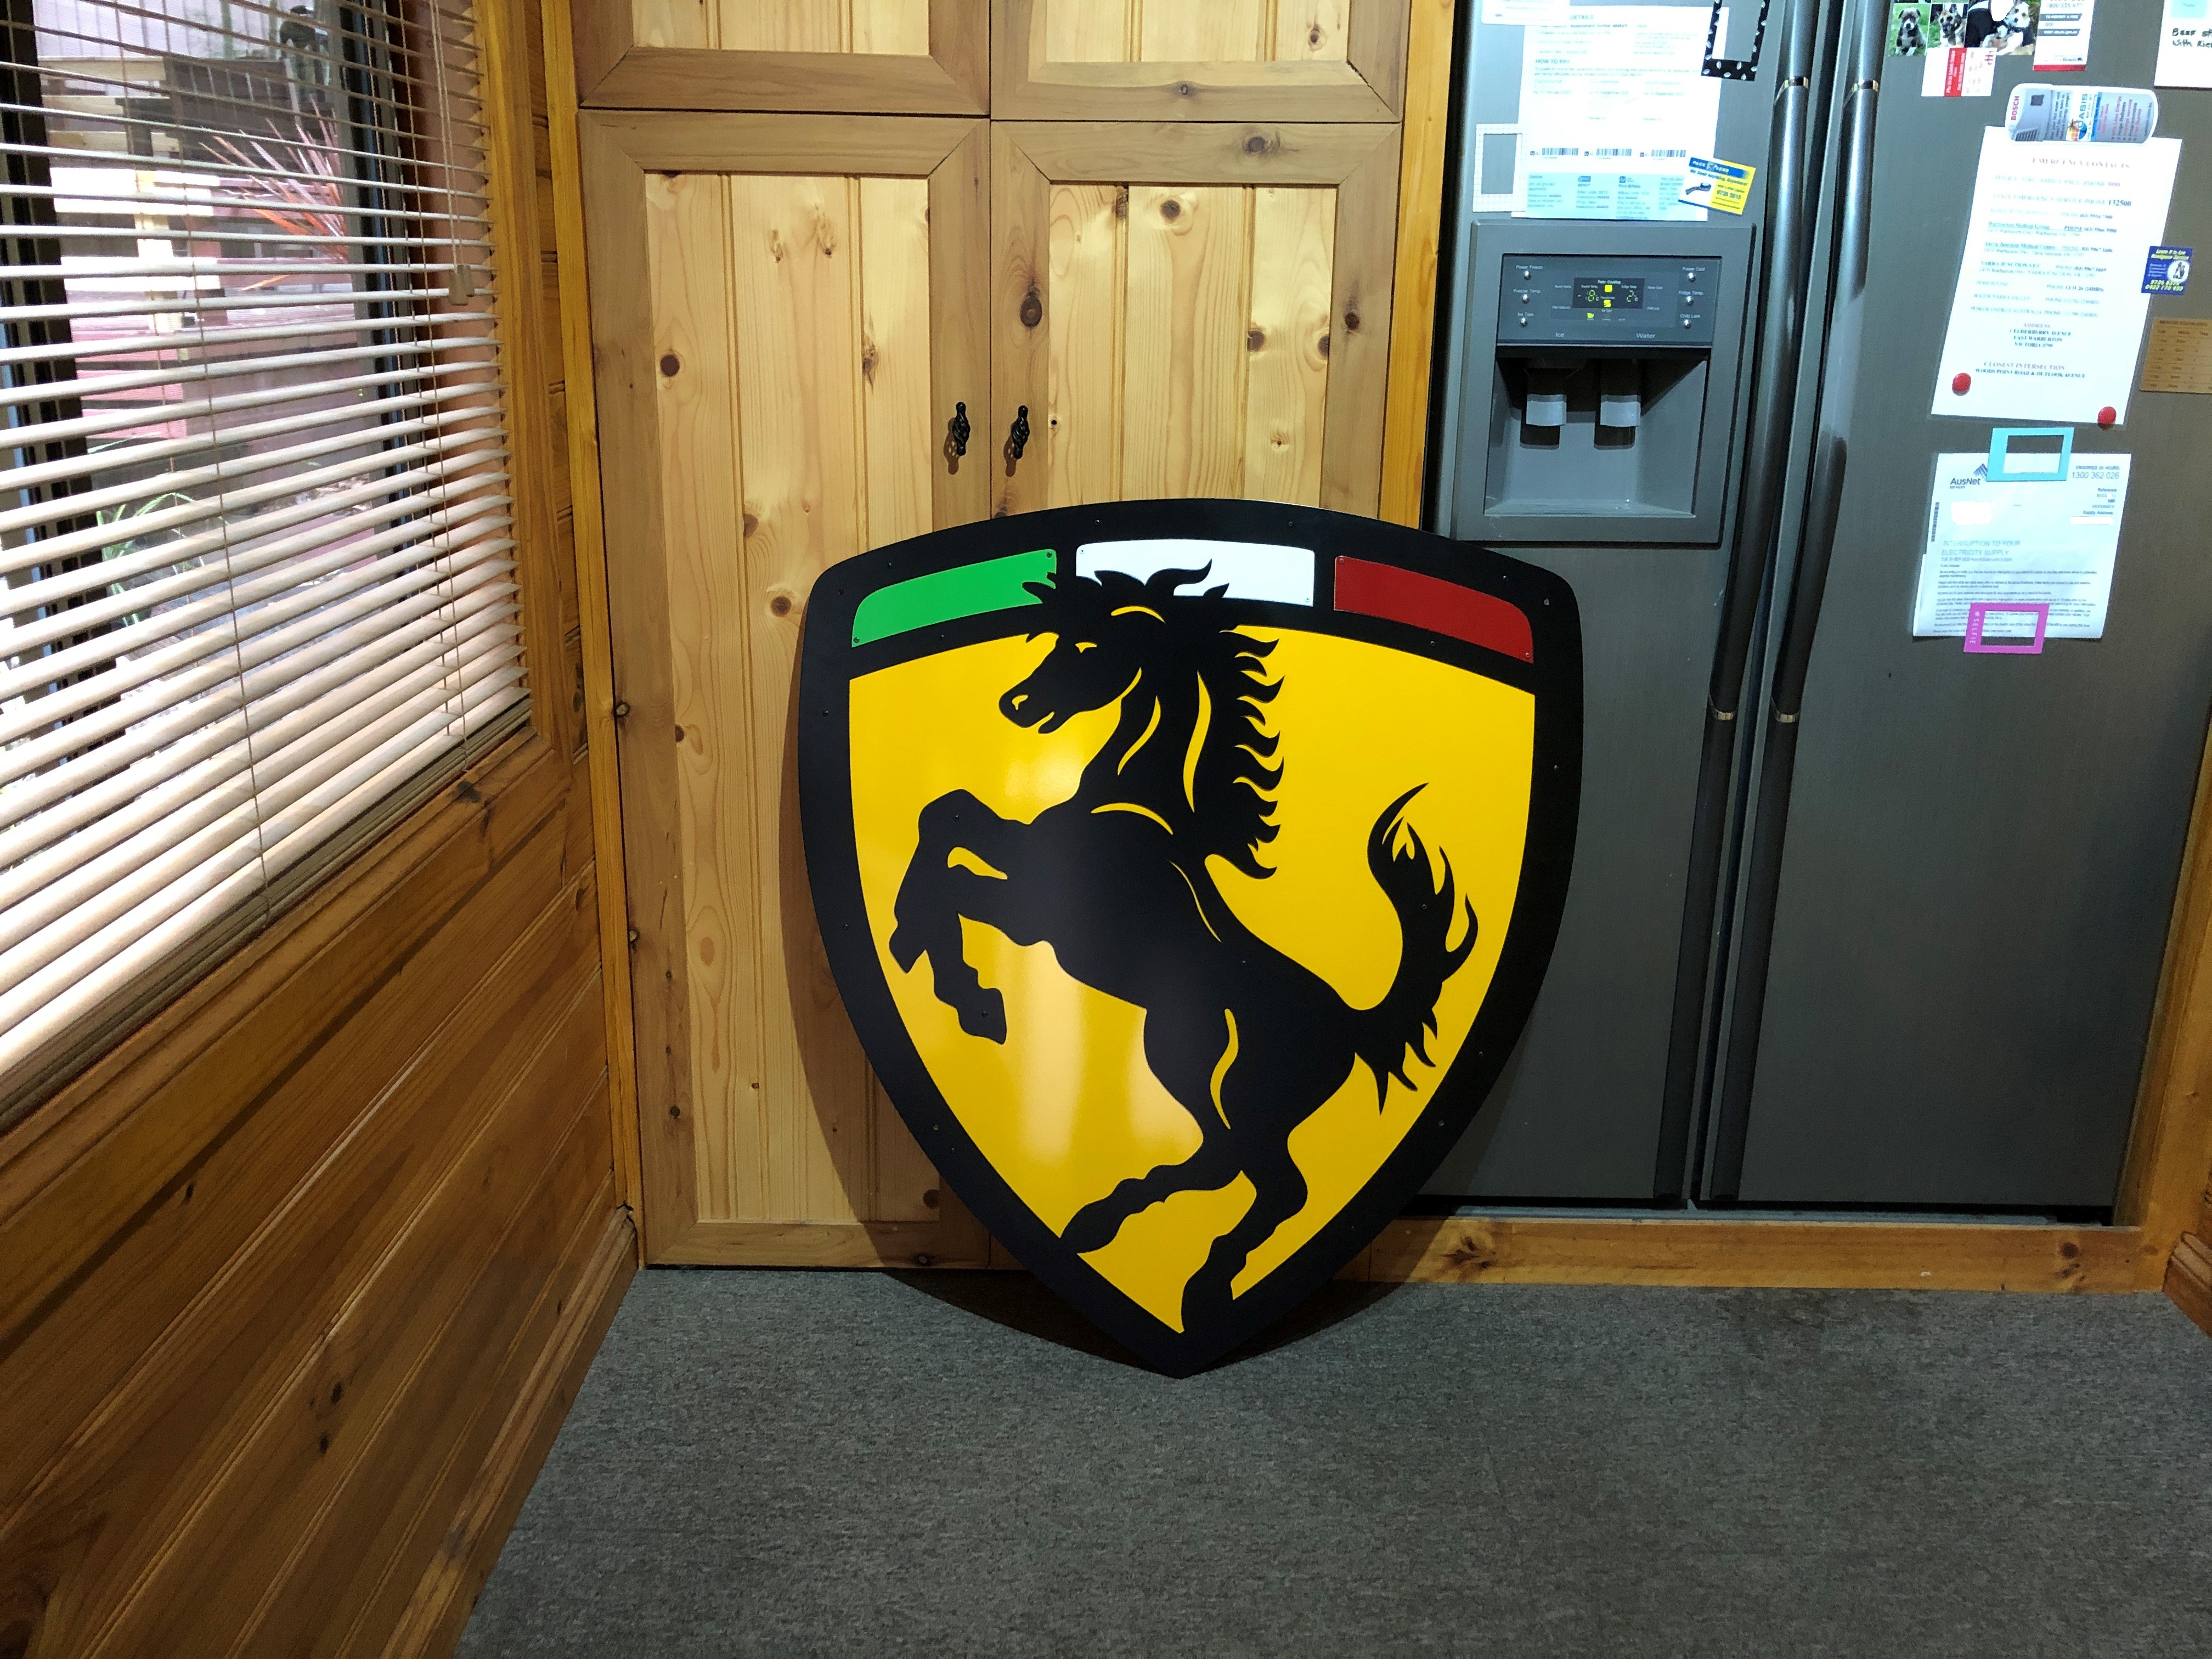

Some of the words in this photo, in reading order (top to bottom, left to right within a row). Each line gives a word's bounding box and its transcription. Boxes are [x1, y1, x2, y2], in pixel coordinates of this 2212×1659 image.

[2011, 95, 2019, 121] BOSCH
[2032, 157, 2083, 166] EMERGENCY
[2086, 160, 2130, 168] CONTACTS
[2108, 199, 2132, 207] 132500
[2016, 362, 2066, 371] INTERSECTION
[2091, 471, 2104, 479] 362
[2106, 471, 2119, 479] 026
